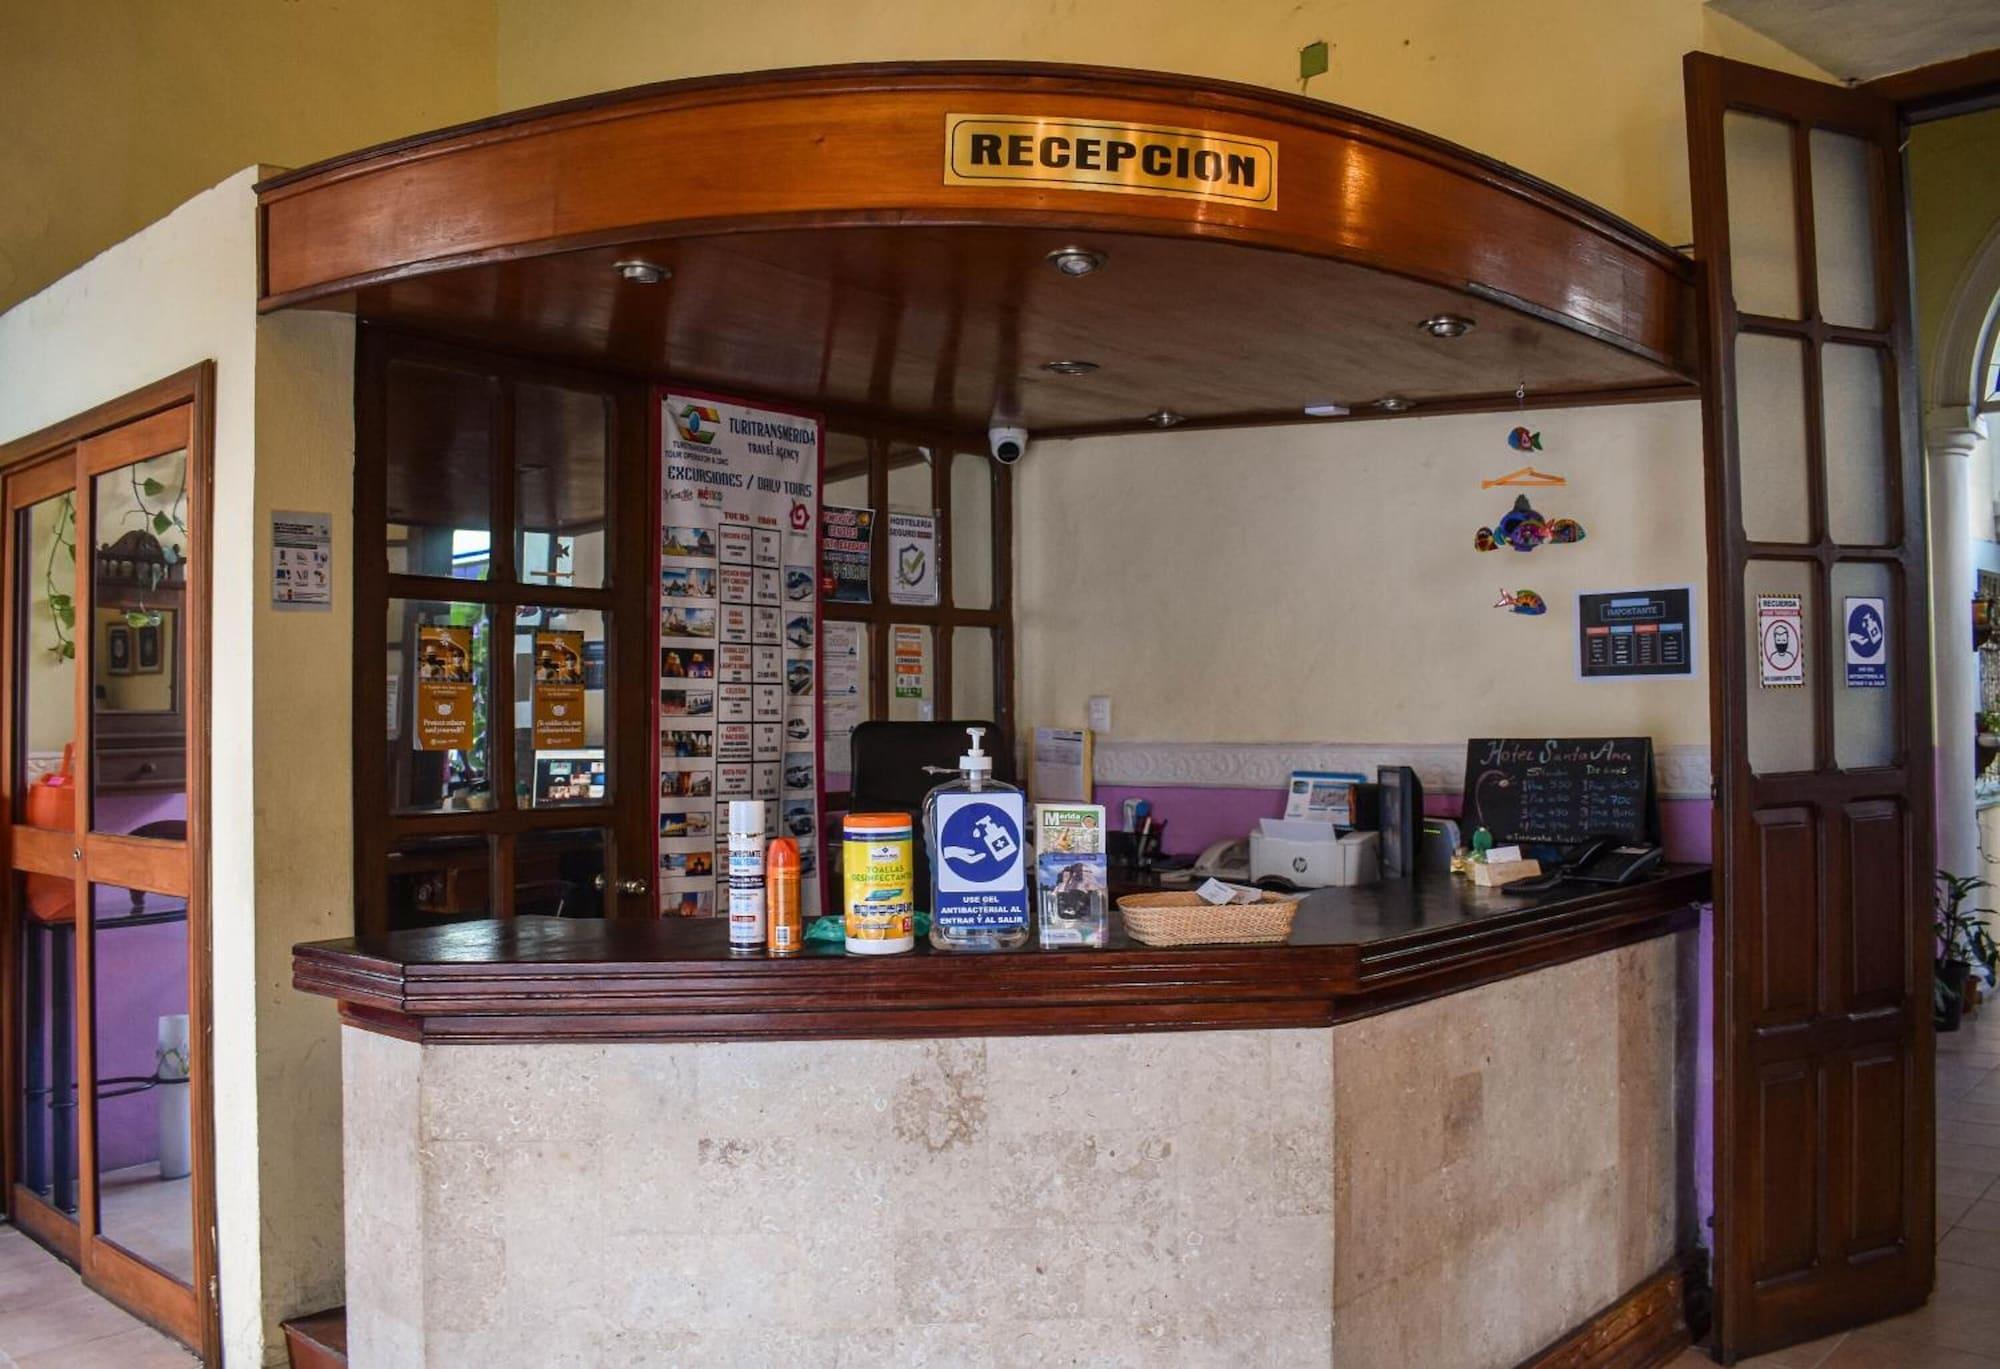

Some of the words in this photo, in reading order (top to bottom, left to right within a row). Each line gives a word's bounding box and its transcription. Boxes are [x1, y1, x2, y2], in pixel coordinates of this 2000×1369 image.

[970, 133, 1256, 187] RECEPCION
[729, 417, 816, 446] TURITRANSMERIDA
[667, 465, 743, 488] EXCURSIONES
[757, 475, 781, 494] DAILY
[784, 480, 812, 498] TOURS
[1607, 606, 1657, 616] IMPORTANTE
[1480, 741, 1536, 765] Hotel
[1539, 740, 1589, 764] Santa
[1590, 740, 1632, 761] Ana
[866, 864, 905, 874] TOALLAS
[962, 896, 980, 904] USE
[982, 895, 1000, 904] GEL
[940, 905, 1009, 914] ANTIBACTERIAL
[1010, 905, 1022, 913] AL
[940, 917, 975, 925] ENTRAR
[998, 915, 1024, 924] SALIR
